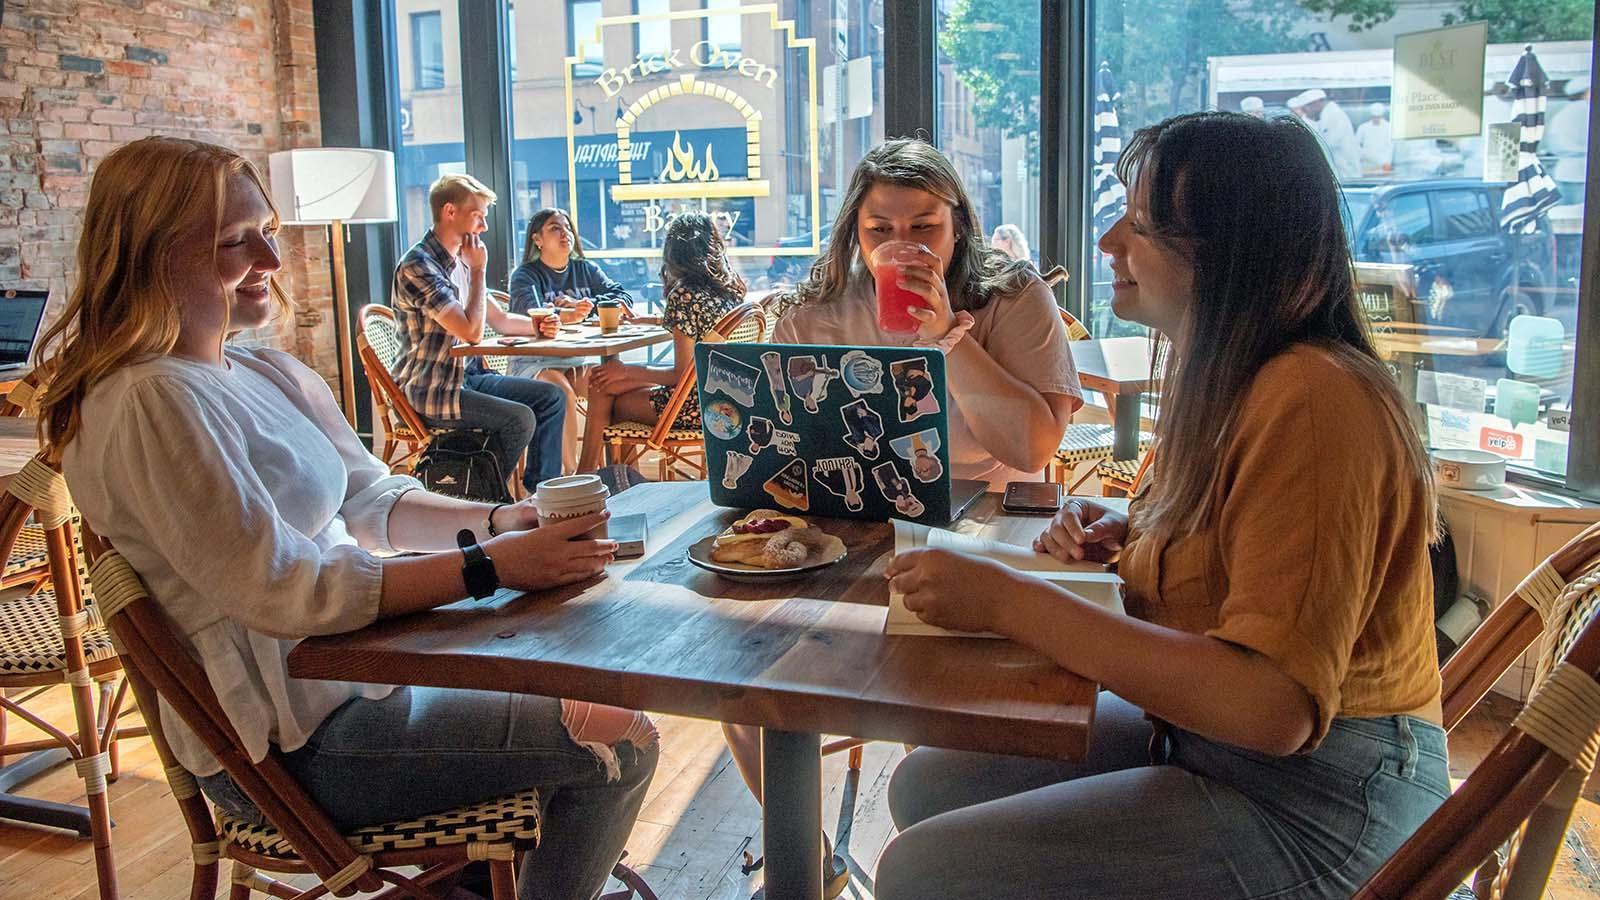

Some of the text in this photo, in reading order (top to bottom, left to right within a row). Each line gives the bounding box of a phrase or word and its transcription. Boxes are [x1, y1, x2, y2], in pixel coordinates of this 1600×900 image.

[594, 40, 778, 100] Brick Oven
[642, 203, 741, 240] Bary
